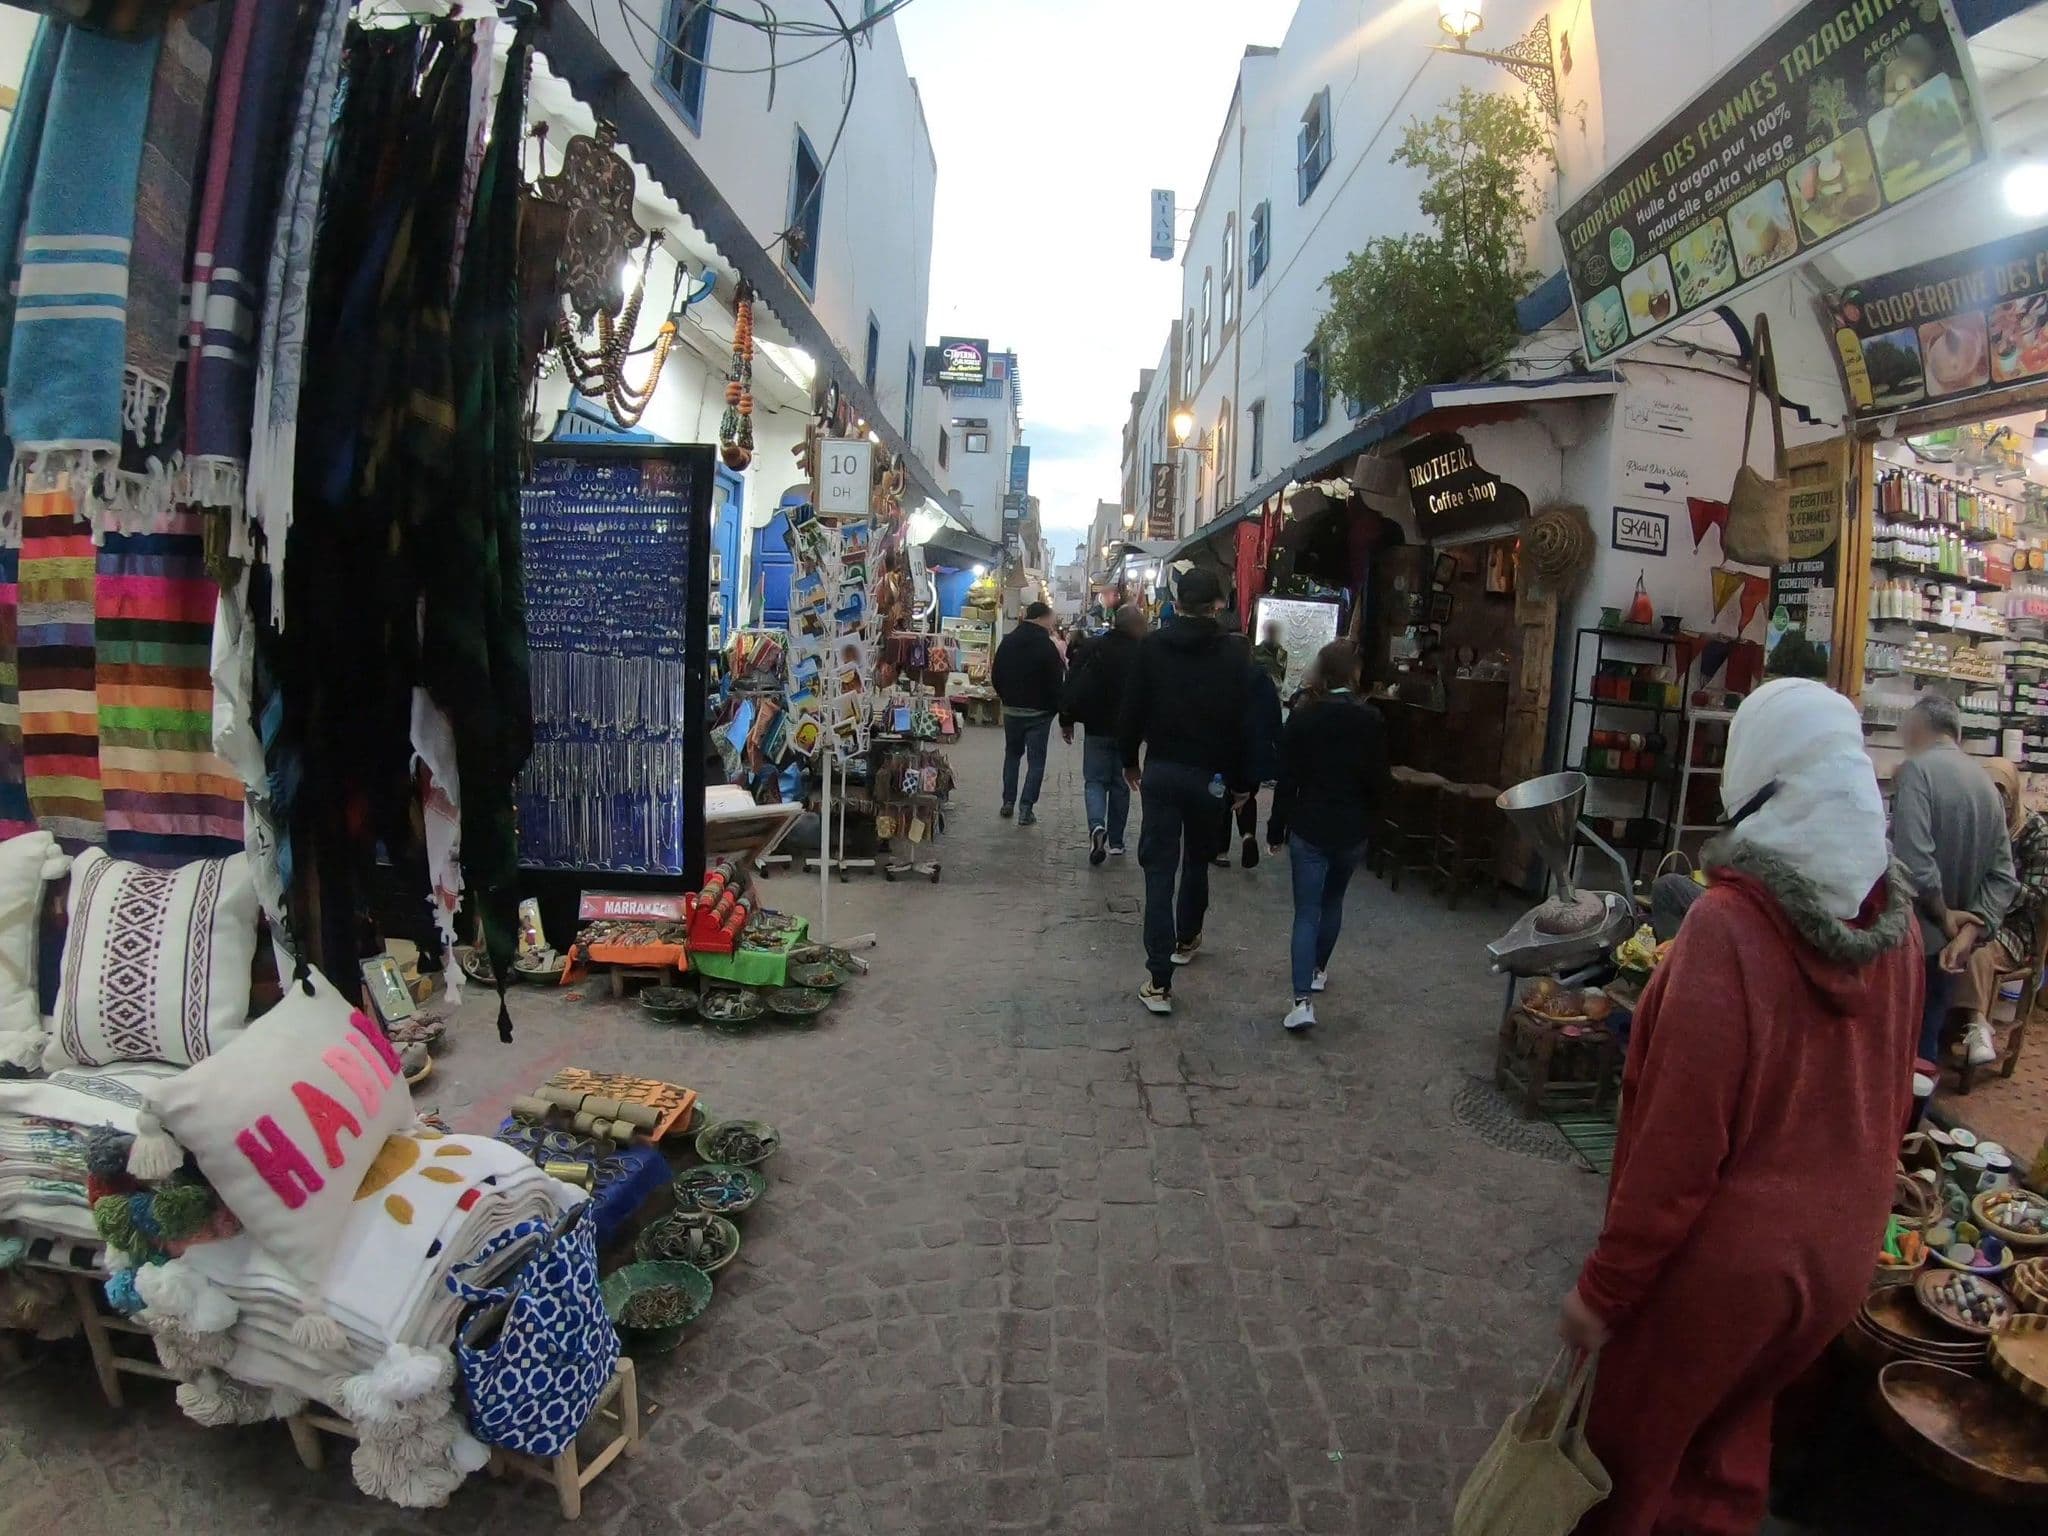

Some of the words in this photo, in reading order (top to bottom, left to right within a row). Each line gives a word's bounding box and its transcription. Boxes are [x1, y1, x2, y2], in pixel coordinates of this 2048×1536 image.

[1863, 17, 1911, 63] ARGAN
[1662, 135, 1696, 177] DES
[1698, 70, 1778, 149] FEMMES
[1668, 157, 1719, 201] d'argan
[1722, 137, 1746, 168] pur
[1749, 102, 1791, 143] 100%
[1157, 191, 1170, 241] RIAD
[1648, 198, 1701, 242] naturelle
[1704, 170, 1741, 202] extra
[830, 455, 857, 475] 10
[832, 487, 851, 498] DH
[1429, 490, 1464, 514] Coffee
[1467, 480, 1497, 502] shop
[1621, 517, 1662, 540] SKALA
